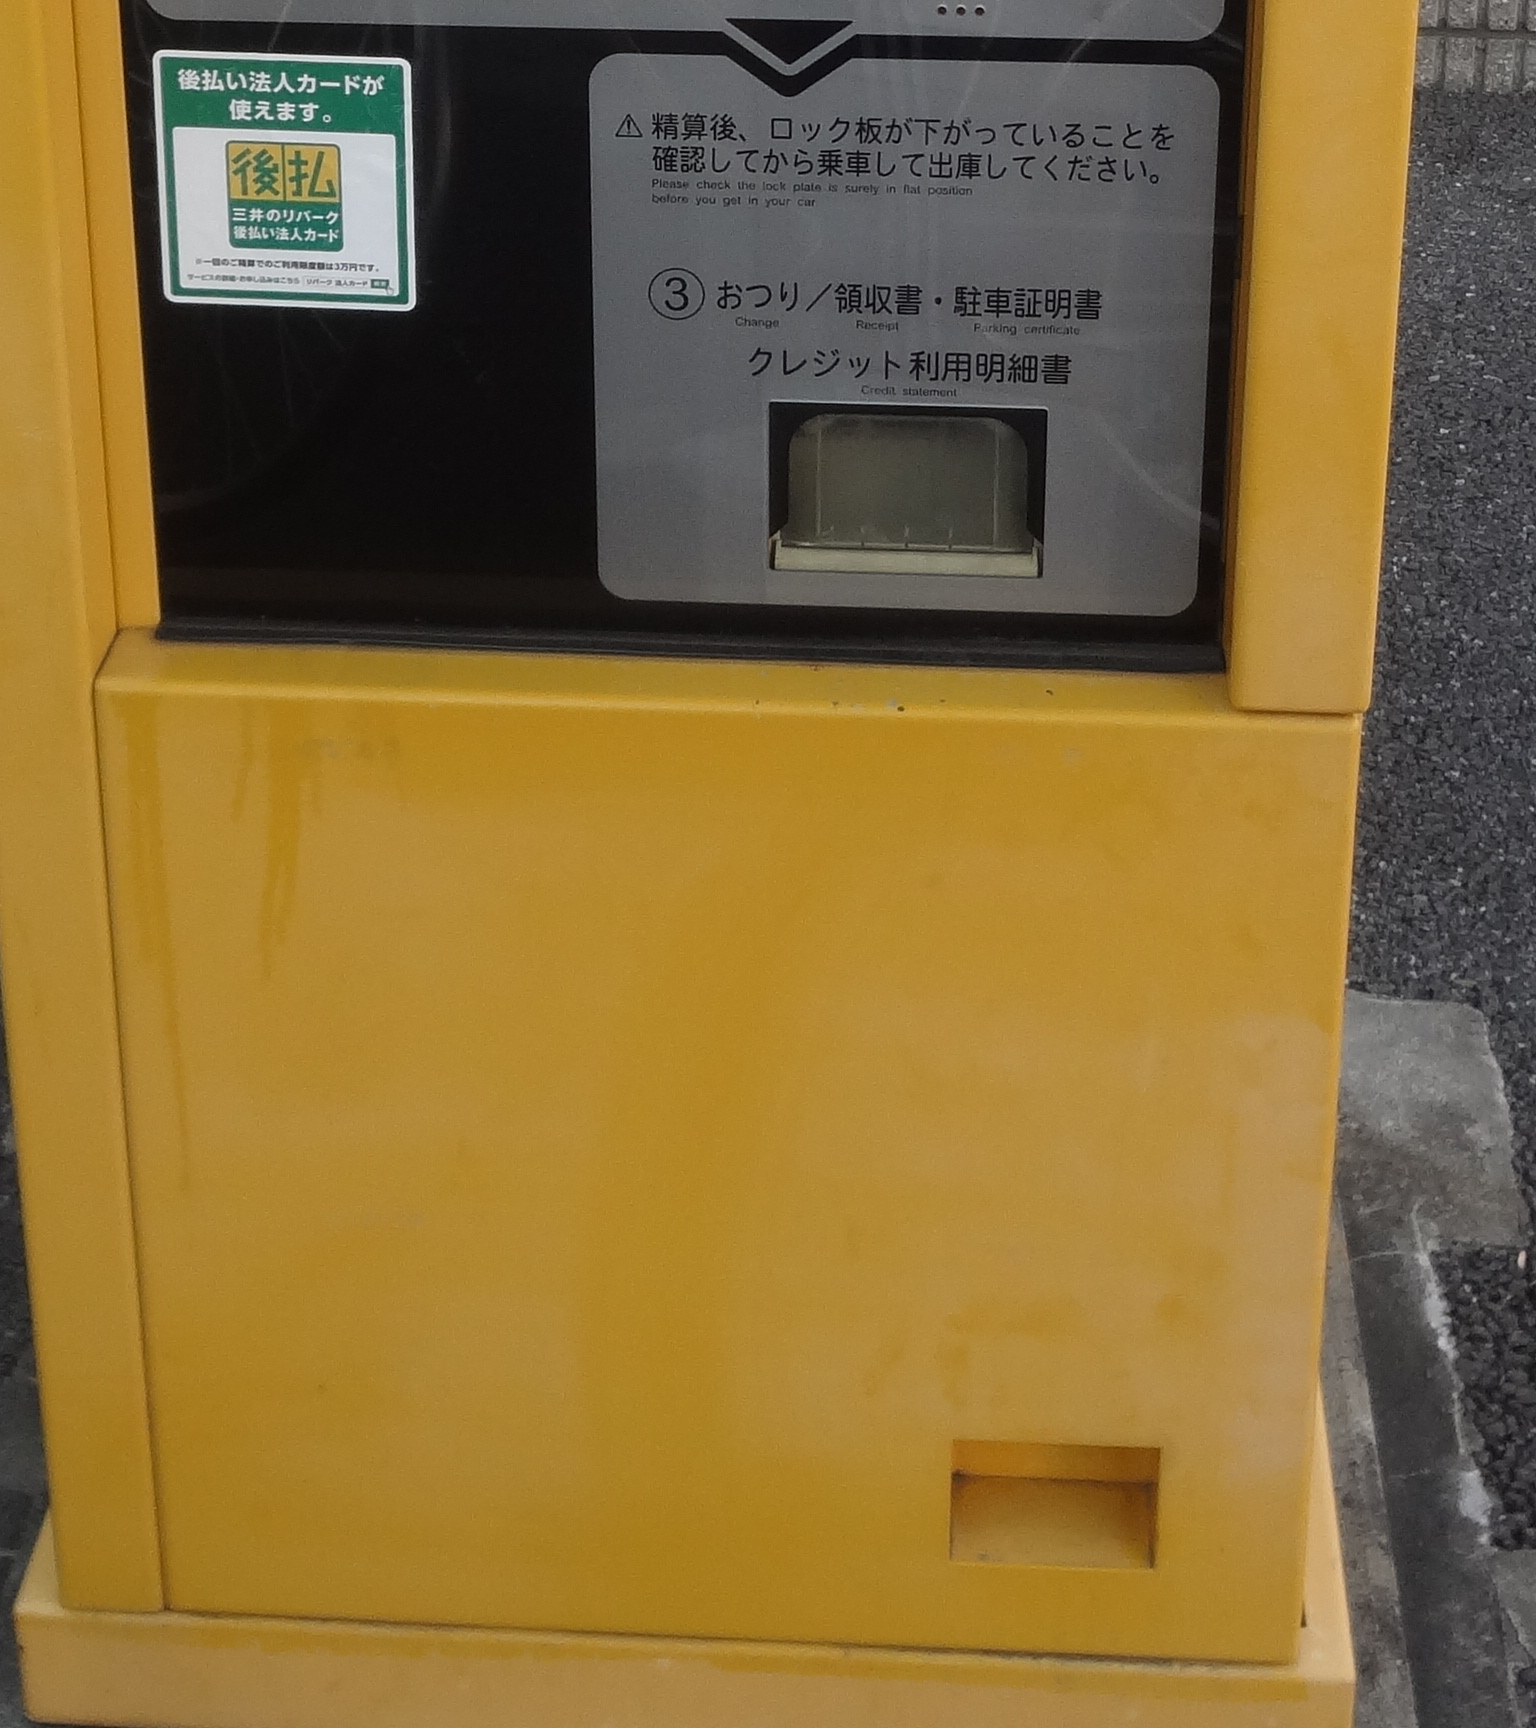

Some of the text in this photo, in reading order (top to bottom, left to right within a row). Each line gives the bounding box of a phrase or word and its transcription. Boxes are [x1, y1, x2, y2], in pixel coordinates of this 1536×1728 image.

[178, 69, 384, 96] 後払い法人カードが
[228, 99, 332, 123] 使えます。
[651, 112, 1176, 153] 精算後、ロック板が下がっていることを
[231, 147, 337, 198] 後払
[651, 144, 1162, 187] 確認してから乗車して出庫してください。
[232, 207, 340, 224] 三井のリパーク
[233, 226, 340, 242] 後払い法人カード
[715, 281, 1104, 322] おつり／領収書・駐車証明書
[748, 346, 1073, 386] クレジット利用明細書
